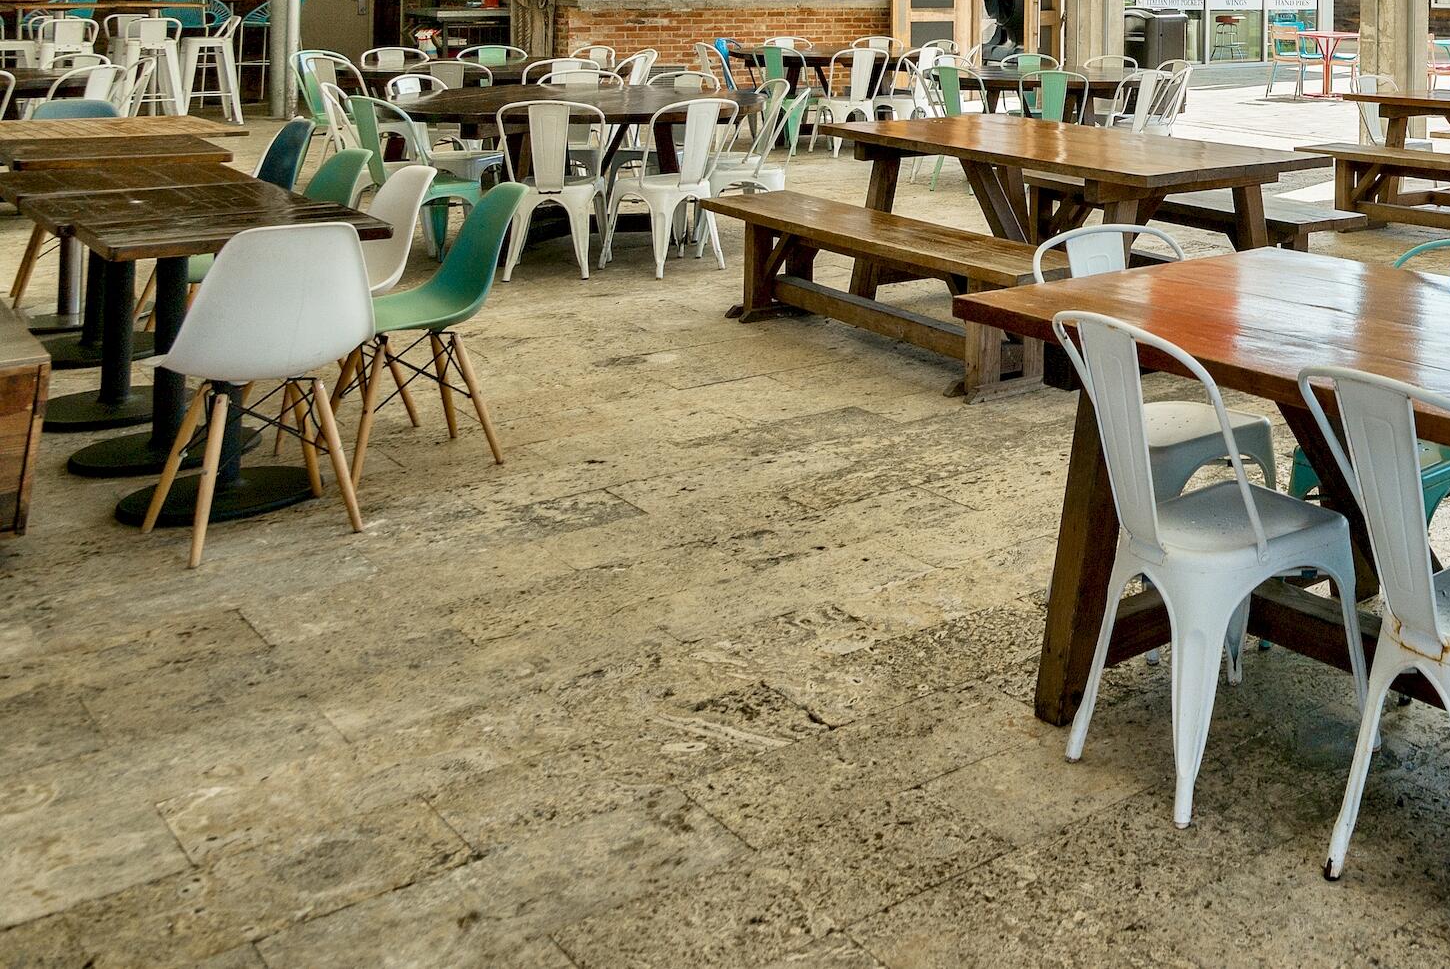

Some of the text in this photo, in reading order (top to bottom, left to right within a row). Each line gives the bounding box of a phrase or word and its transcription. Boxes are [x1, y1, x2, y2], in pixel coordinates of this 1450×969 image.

[1180, 0, 1204, 7] POCKETS
[1225, 0, 1248, 7] WINGS
[1275, 0, 1295, 7] HAND
